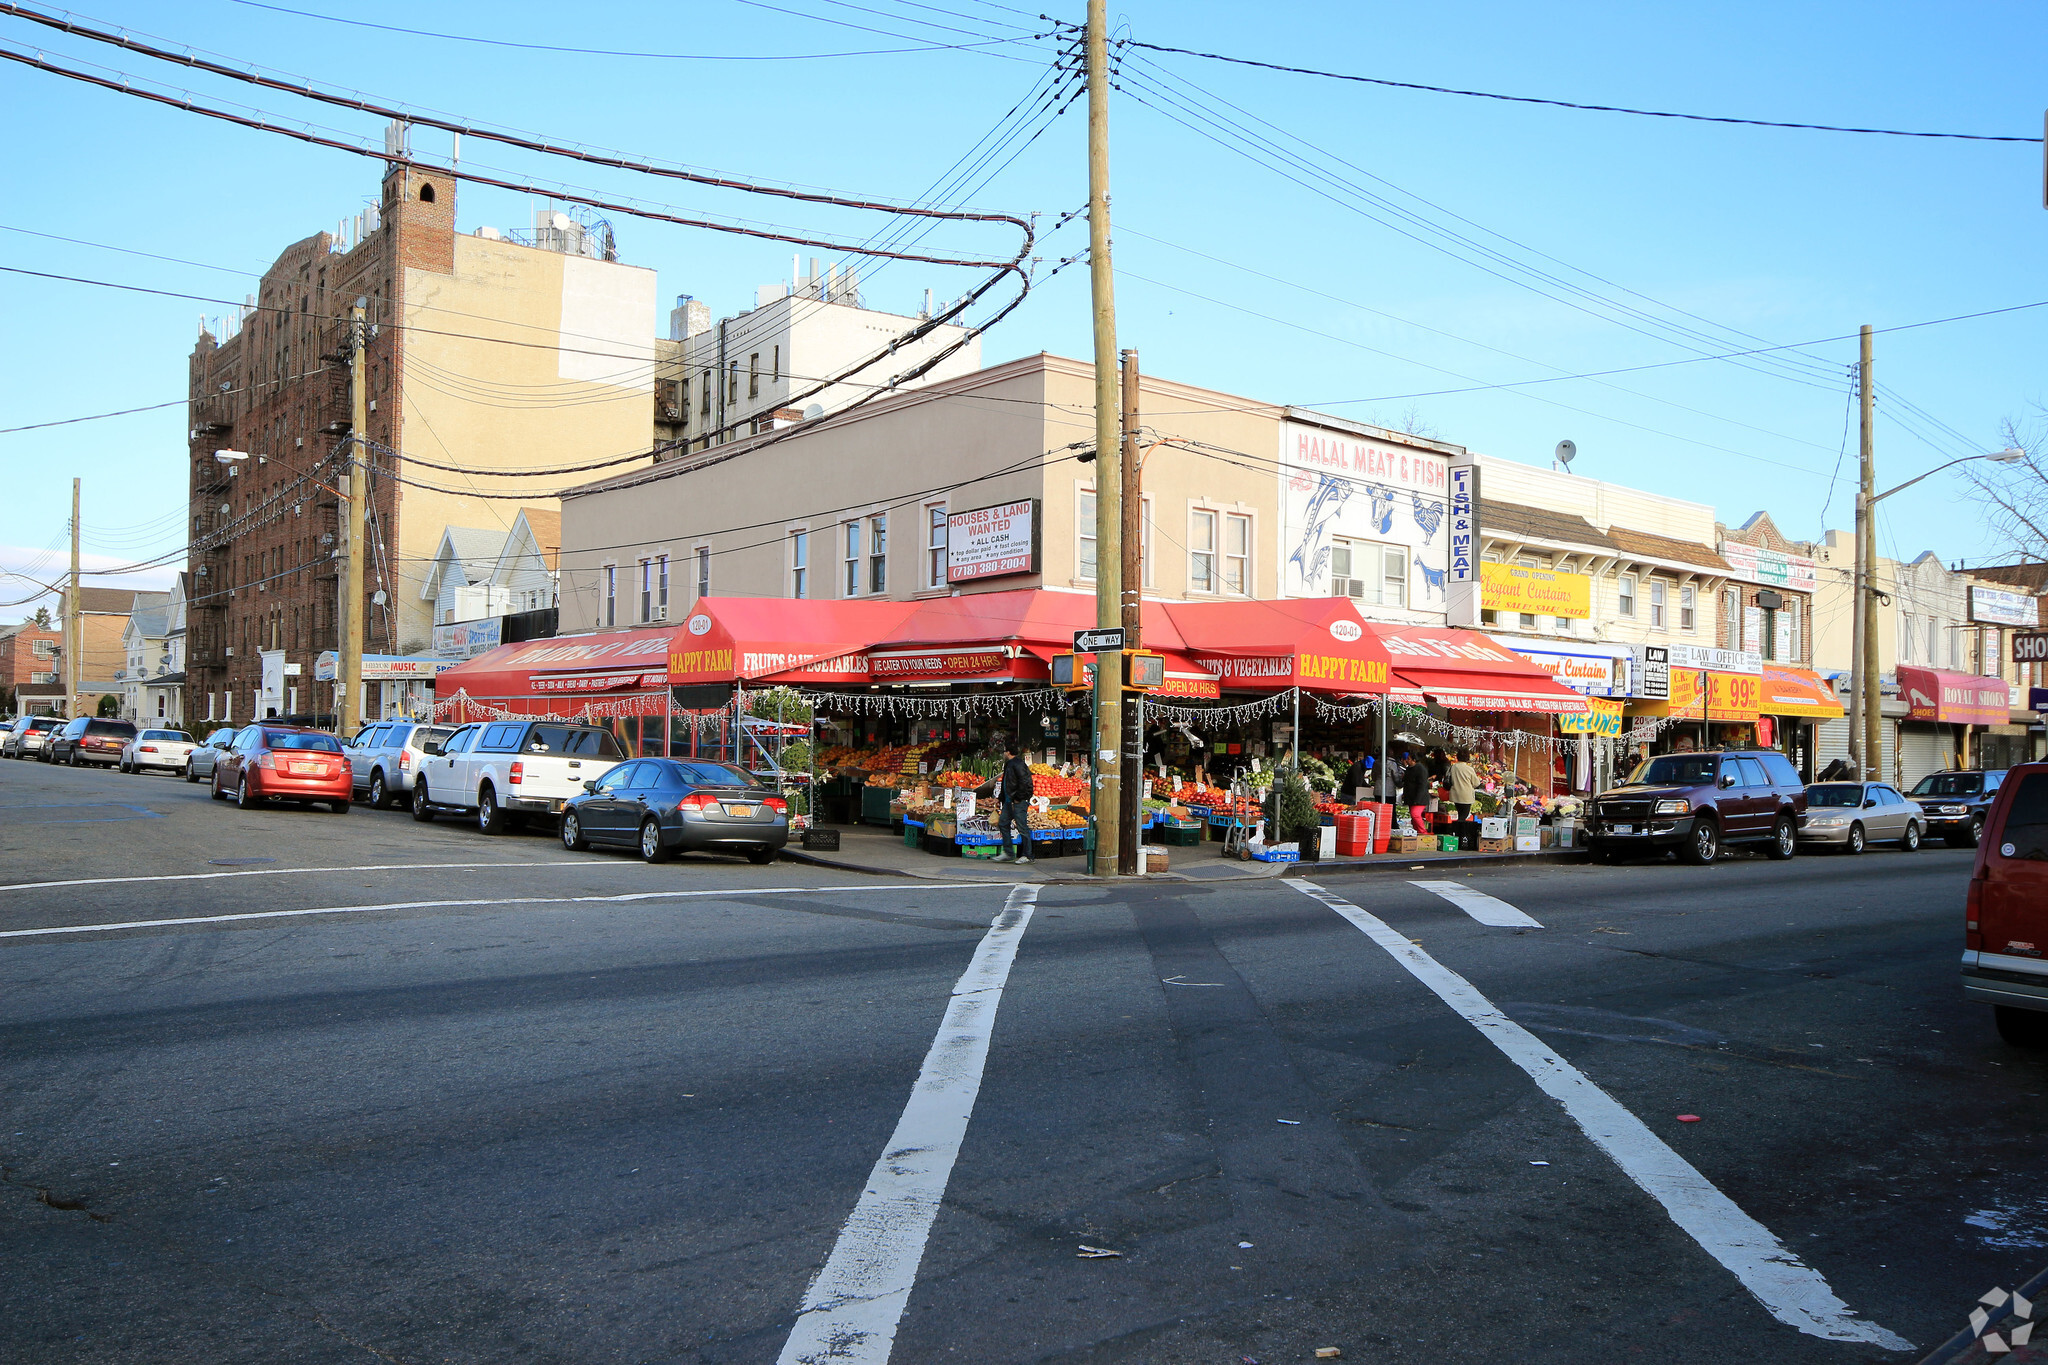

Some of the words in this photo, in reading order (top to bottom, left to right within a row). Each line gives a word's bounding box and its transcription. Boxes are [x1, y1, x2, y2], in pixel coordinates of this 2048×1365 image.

[1298, 434, 1348, 469] HALAL
[1353, 445, 1395, 478] MEAT
[1400, 455, 1409, 482] &
[1413, 458, 1445, 488] FISH
[1454, 470, 1469, 515] FISH
[950, 511, 989, 527] HOUSES
[993, 508, 1000, 520] &
[1003, 503, 1030, 518] LAND
[968, 519, 1011, 536] WANTED
[1455, 520, 1469, 530] &
[976, 537, 989, 545] ALL
[991, 534, 1009, 543] CASH
[1453, 534, 1469, 578] MEAT
[953, 565, 977, 578] (718)
[980, 557, 1026, 573] 380-2004
[1758, 561, 1779, 573] TRAVEL
[1510, 569, 1529, 578] GRAND
[1532, 571, 1556, 581] OPENING
[1480, 575, 1521, 600] Elegant
[1527, 582, 1572, 603] Curtains
[1505, 601, 1532, 611] SALE!
[1535, 604, 1559, 613] SALE!
[1564, 607, 1588, 616] SALE!
[692, 618, 709, 631] 120-01
[1335, 624, 1358, 637] 120-01
[469, 630, 486, 644] SPORTS
[1083, 637, 1098, 646] ONE
[1105, 635, 1120, 644] WAY
[1648, 649, 1664, 661] LAW
[2015, 637, 2048, 659] SHO
[670, 650, 702, 674] HAPPY
[705, 649, 733, 672] FARM
[743, 652, 786, 673] FRUITS
[874, 660, 882, 671] WE
[882, 659, 900, 671] CATER
[900, 659, 909, 670] TO
[909, 658, 923, 670] YOUR
[924, 658, 943, 670] NEEDS
[947, 656, 969, 668] OPEN
[971, 656, 981, 668] 24
[981, 655, 1000, 667] HRS
[1691, 648, 1711, 661] LAW
[1716, 651, 1745, 664] OFFICE
[391, 663, 416, 671] MUSIC
[1224, 659, 1232, 678] &
[1233, 657, 1292, 677] VEGETABLES
[1300, 653, 1347, 681] HAPPY
[1350, 659, 1387, 684] FARM
[1565, 658, 1606, 679] Curtains
[1646, 661, 1667, 673] OFFICE
[1674, 671, 1688, 683] C.K.
[1166, 680, 1188, 693] OPEN
[1189, 681, 1198, 693] 24
[1199, 682, 1217, 694] HRS
[1673, 683, 1690, 693] GROCERY
[1471, 697, 1485, 706] FRESH
[1486, 697, 1506, 708] SEAFOOD
[1534, 700, 1550, 709] FROZEN
[1562, 701, 1588, 711] VEGETABLES
[1944, 687, 1974, 705] ROYAL
[1979, 690, 2005, 707] SHOES
[1912, 708, 1935, 717] SHOES
